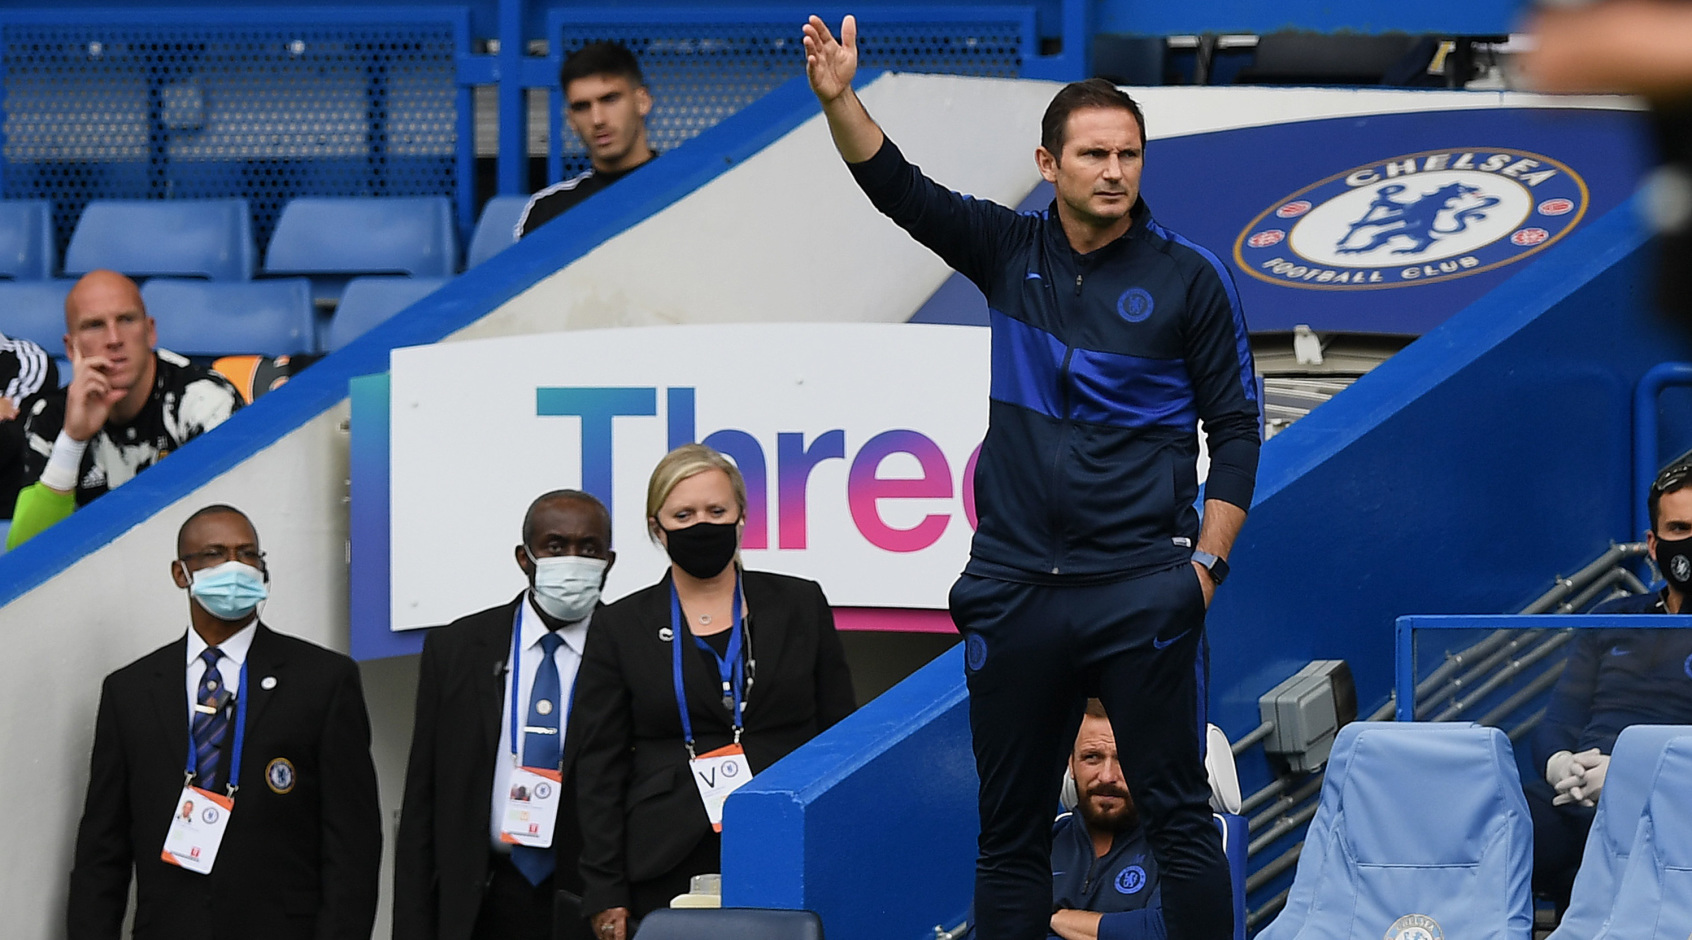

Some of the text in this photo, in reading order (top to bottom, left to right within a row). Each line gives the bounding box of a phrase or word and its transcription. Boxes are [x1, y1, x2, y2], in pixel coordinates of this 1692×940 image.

[1346, 153, 1557, 187] CHELSEA
[1262, 256, 1479, 283] FOOTBALL CLUB
[536, 387, 982, 552] Thre
[699, 766, 715, 788] V
